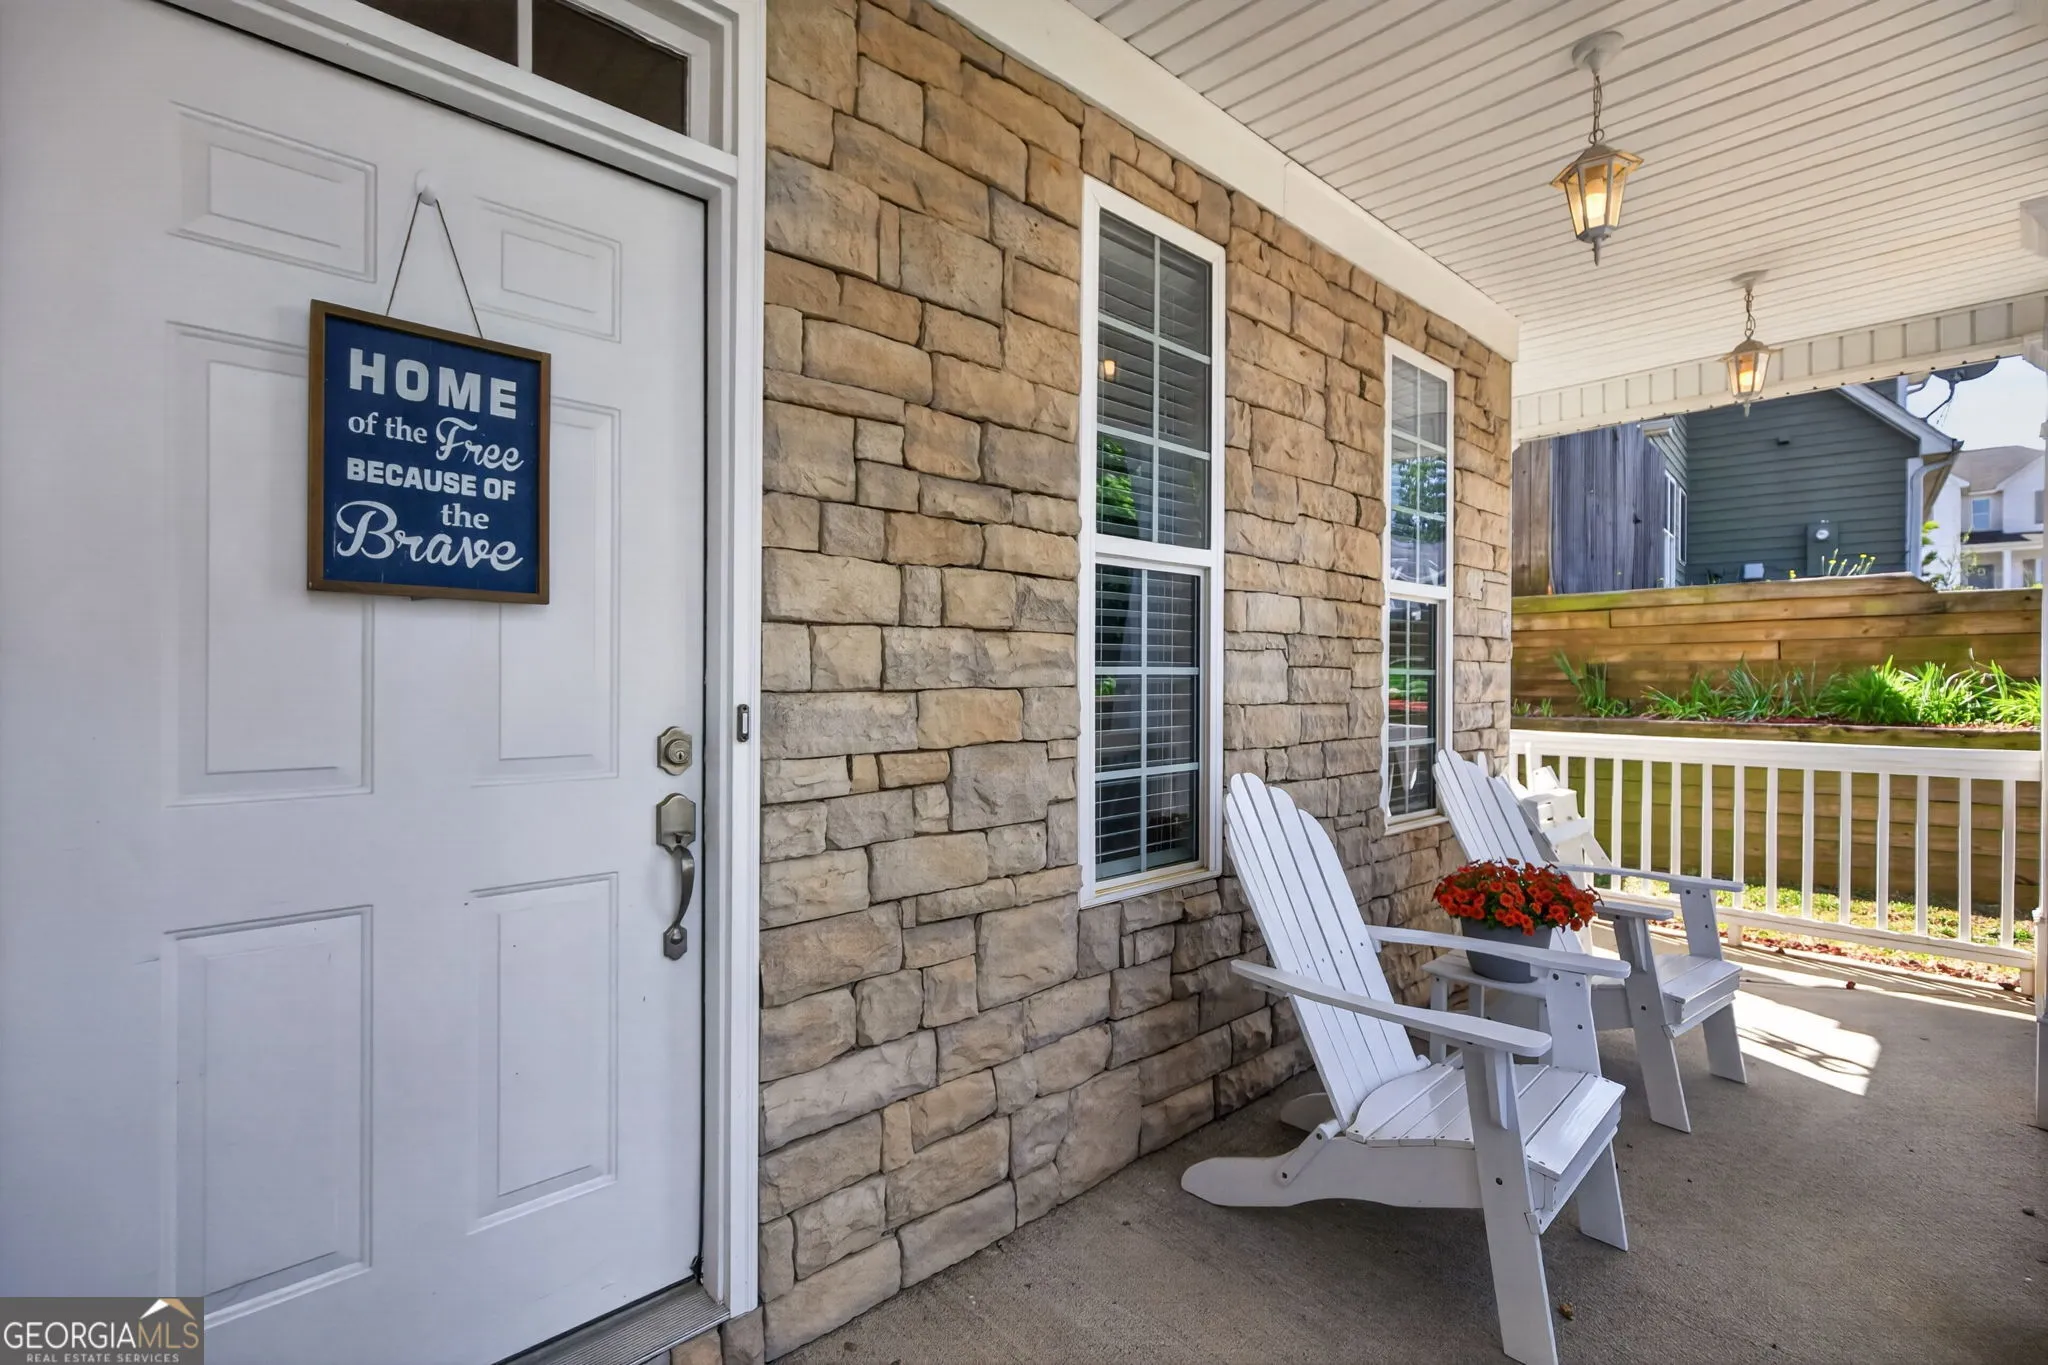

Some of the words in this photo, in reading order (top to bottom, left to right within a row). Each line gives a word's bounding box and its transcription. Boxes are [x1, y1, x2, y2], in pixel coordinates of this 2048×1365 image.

[349, 347, 517, 420] HOME
[348, 412, 378, 436] of
[385, 416, 428, 444] the
[436, 416, 524, 472] Free
[346, 456, 477, 497] BECAUSE
[483, 477, 516, 501] OF
[336, 500, 524, 572] Brave
[440, 503, 490, 530] the
